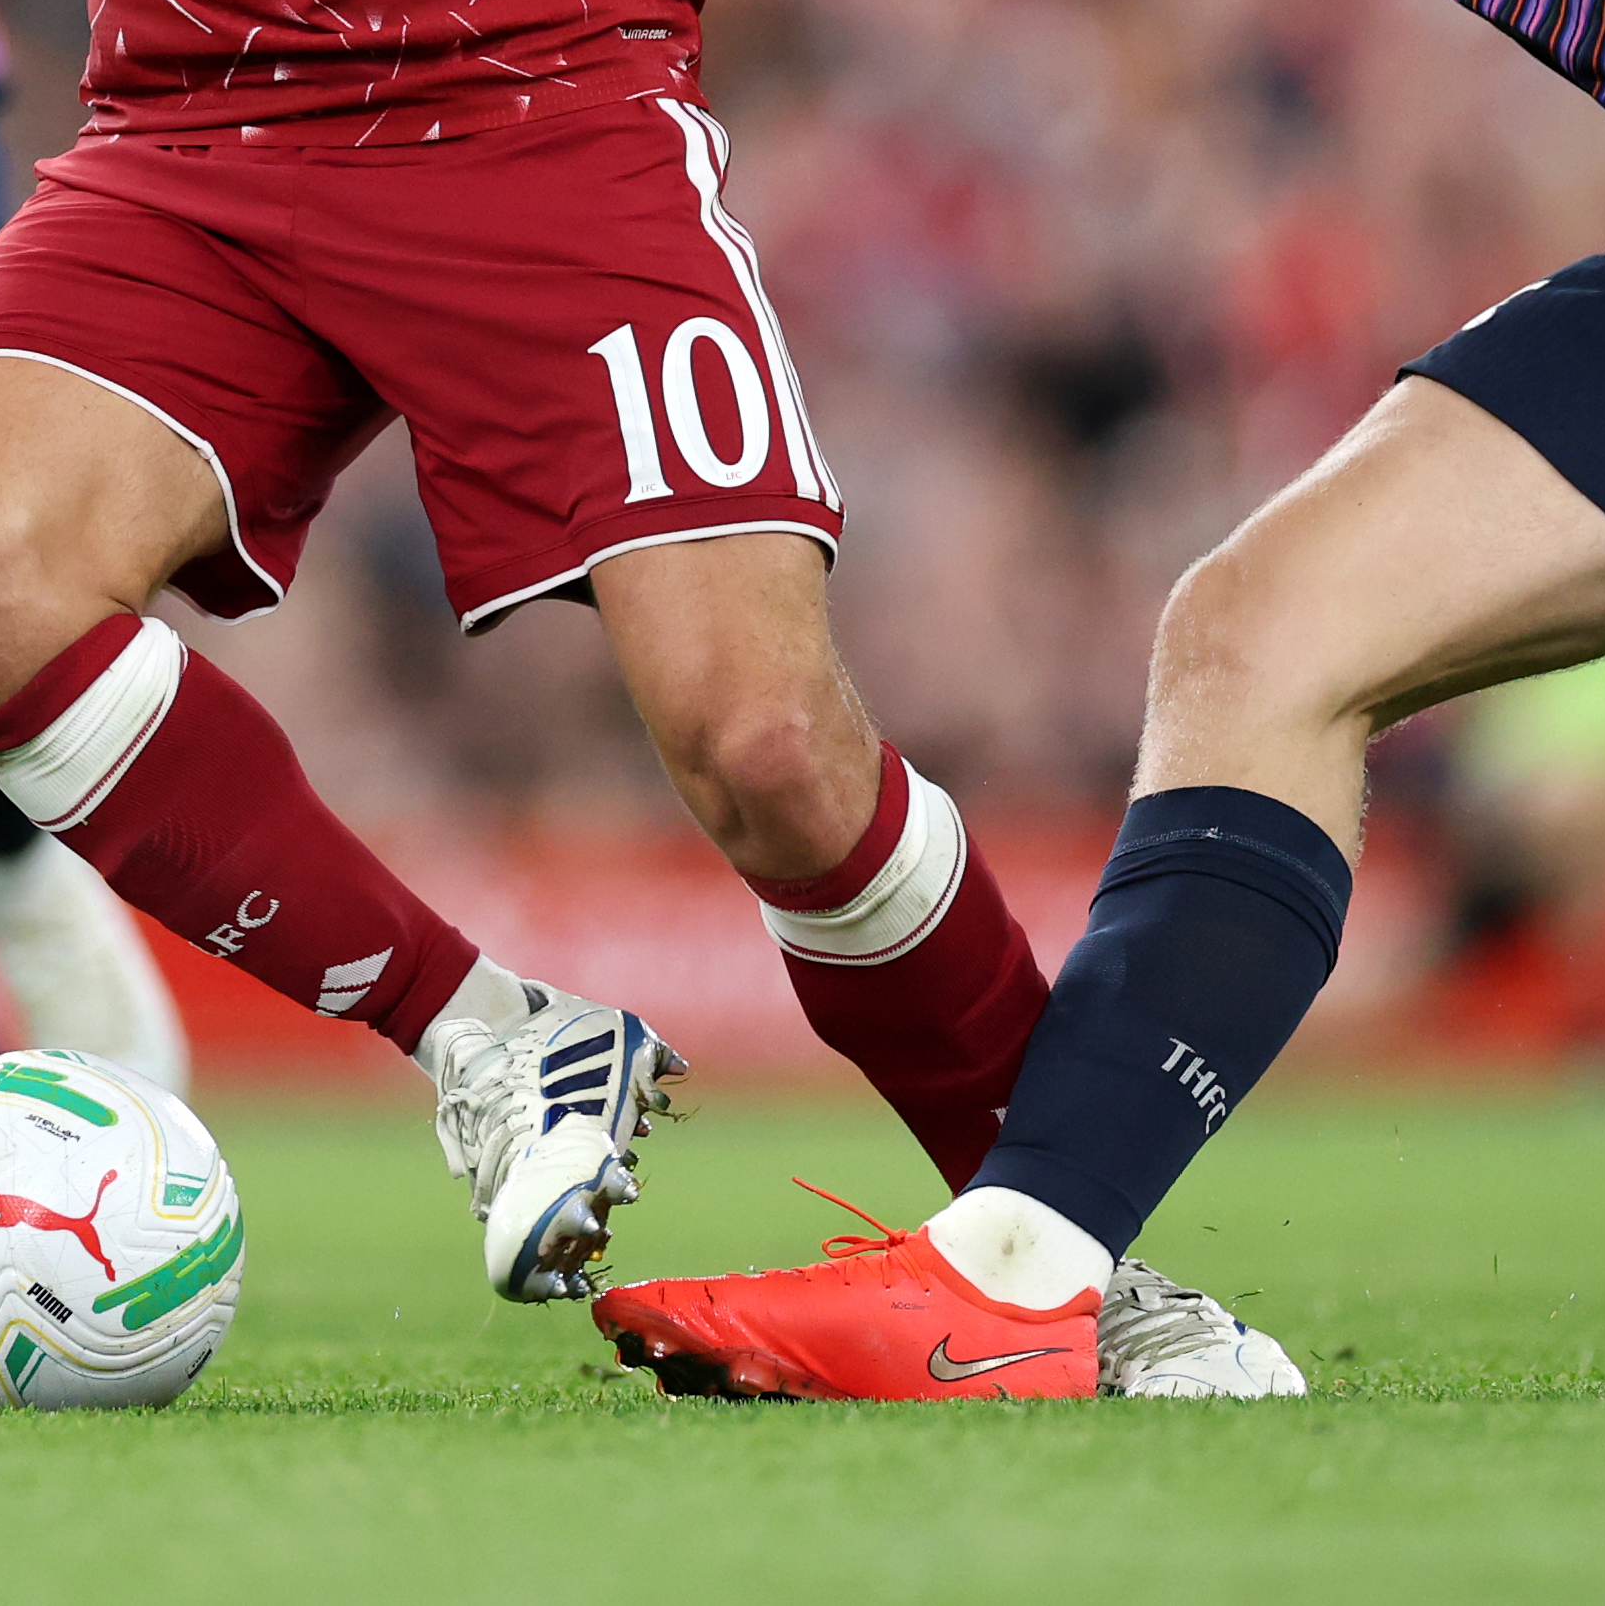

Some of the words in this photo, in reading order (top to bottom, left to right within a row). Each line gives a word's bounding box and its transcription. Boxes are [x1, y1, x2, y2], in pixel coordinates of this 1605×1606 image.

[587, 316, 771, 504] 10
[640, 483, 657, 494] LFC
[725, 471, 743, 481] LFC
[188, 889, 281, 958] FC
[1160, 1037, 1226, 1135] THFC
[26, 1281, 74, 1324] PUMA
